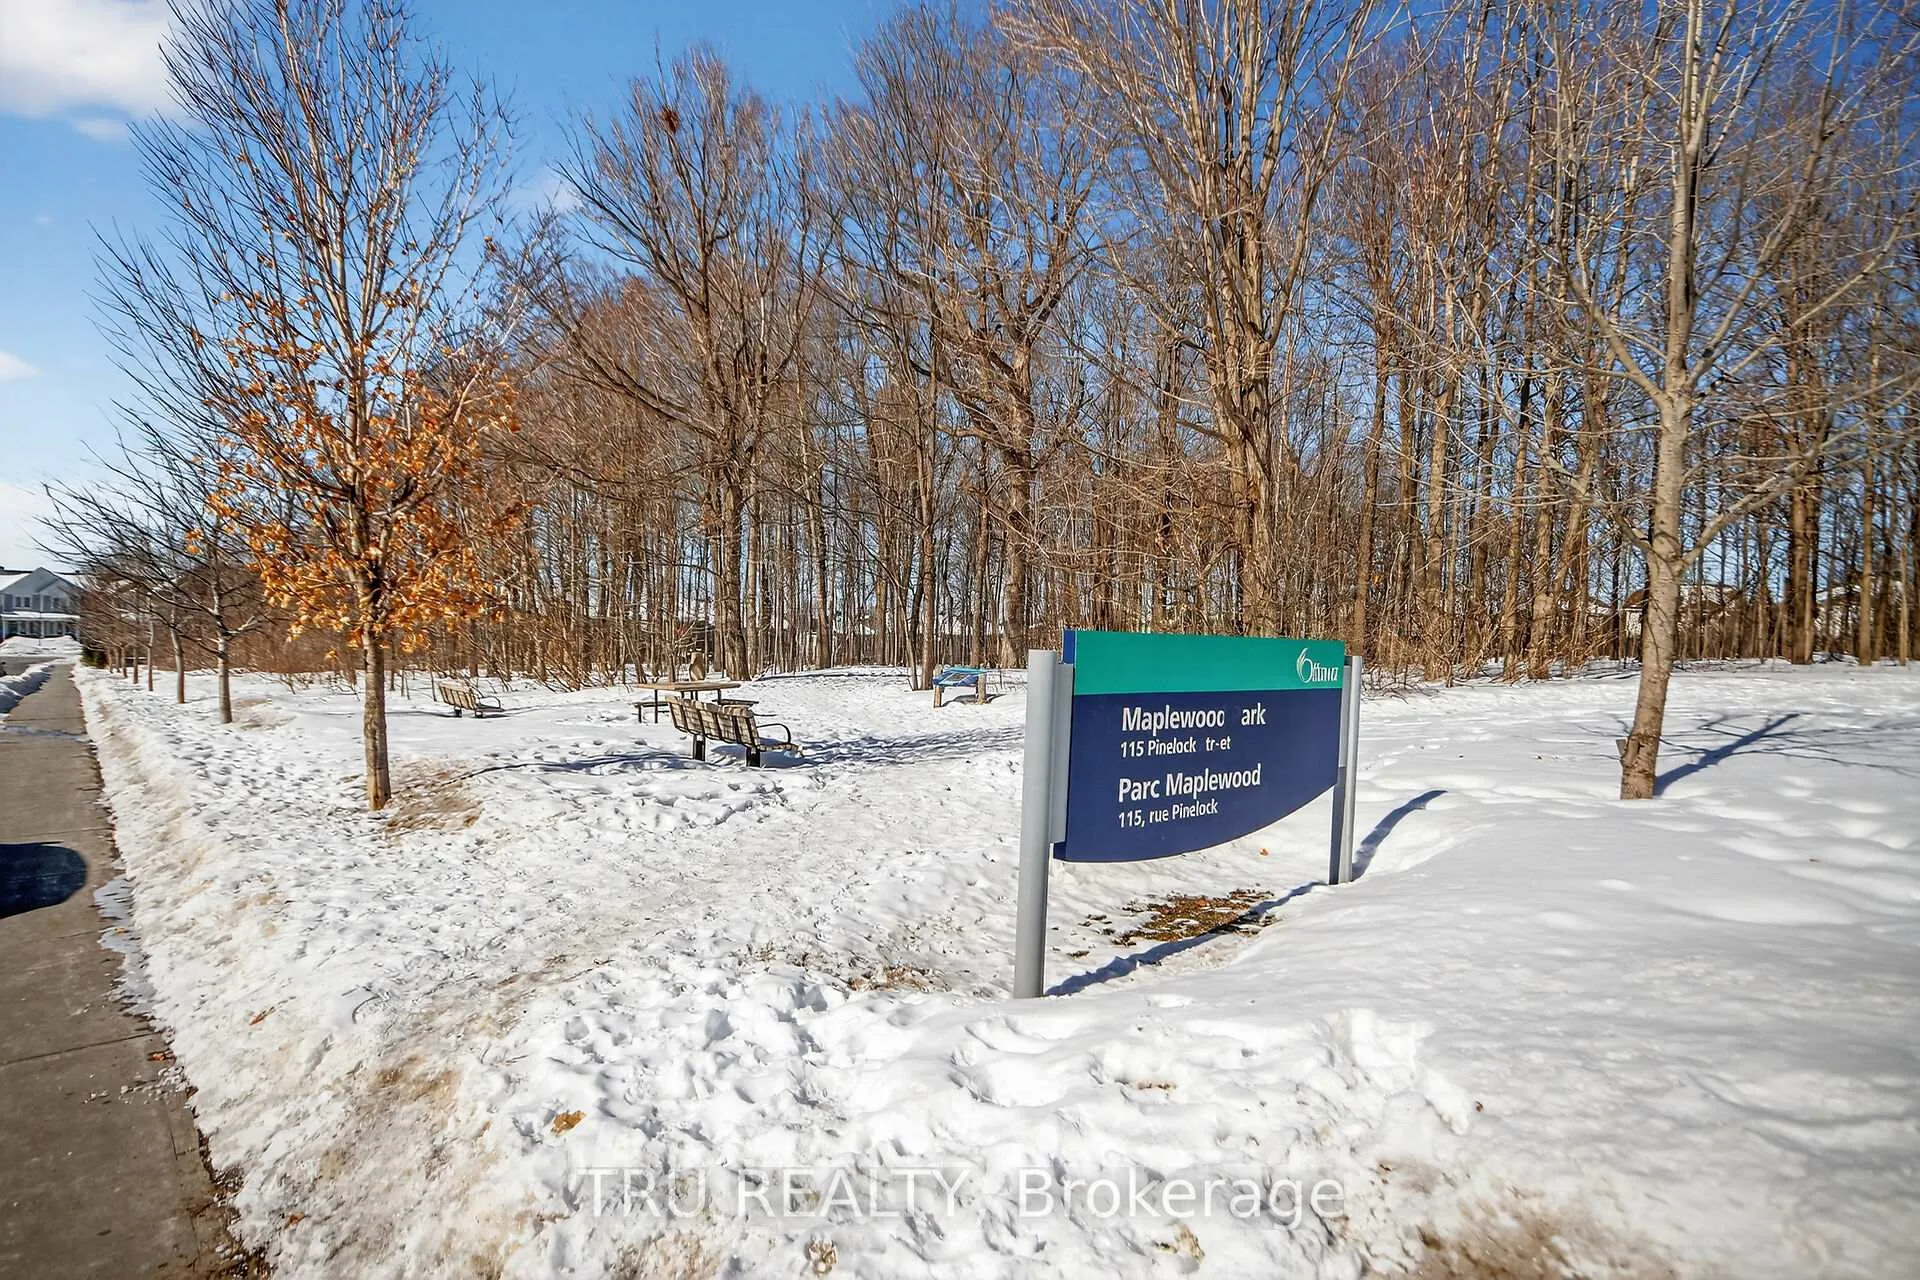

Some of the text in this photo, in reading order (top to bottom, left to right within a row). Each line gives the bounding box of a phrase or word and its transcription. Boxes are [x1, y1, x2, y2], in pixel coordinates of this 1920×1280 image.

[1240, 702, 1267, 727] ark
[1120, 740, 1144, 758] 115
[1147, 736, 1197, 757] Pinelock
[1118, 762, 1262, 803] Parc Maplewood
[1118, 798, 1219, 828] 115, rue Pinelock
